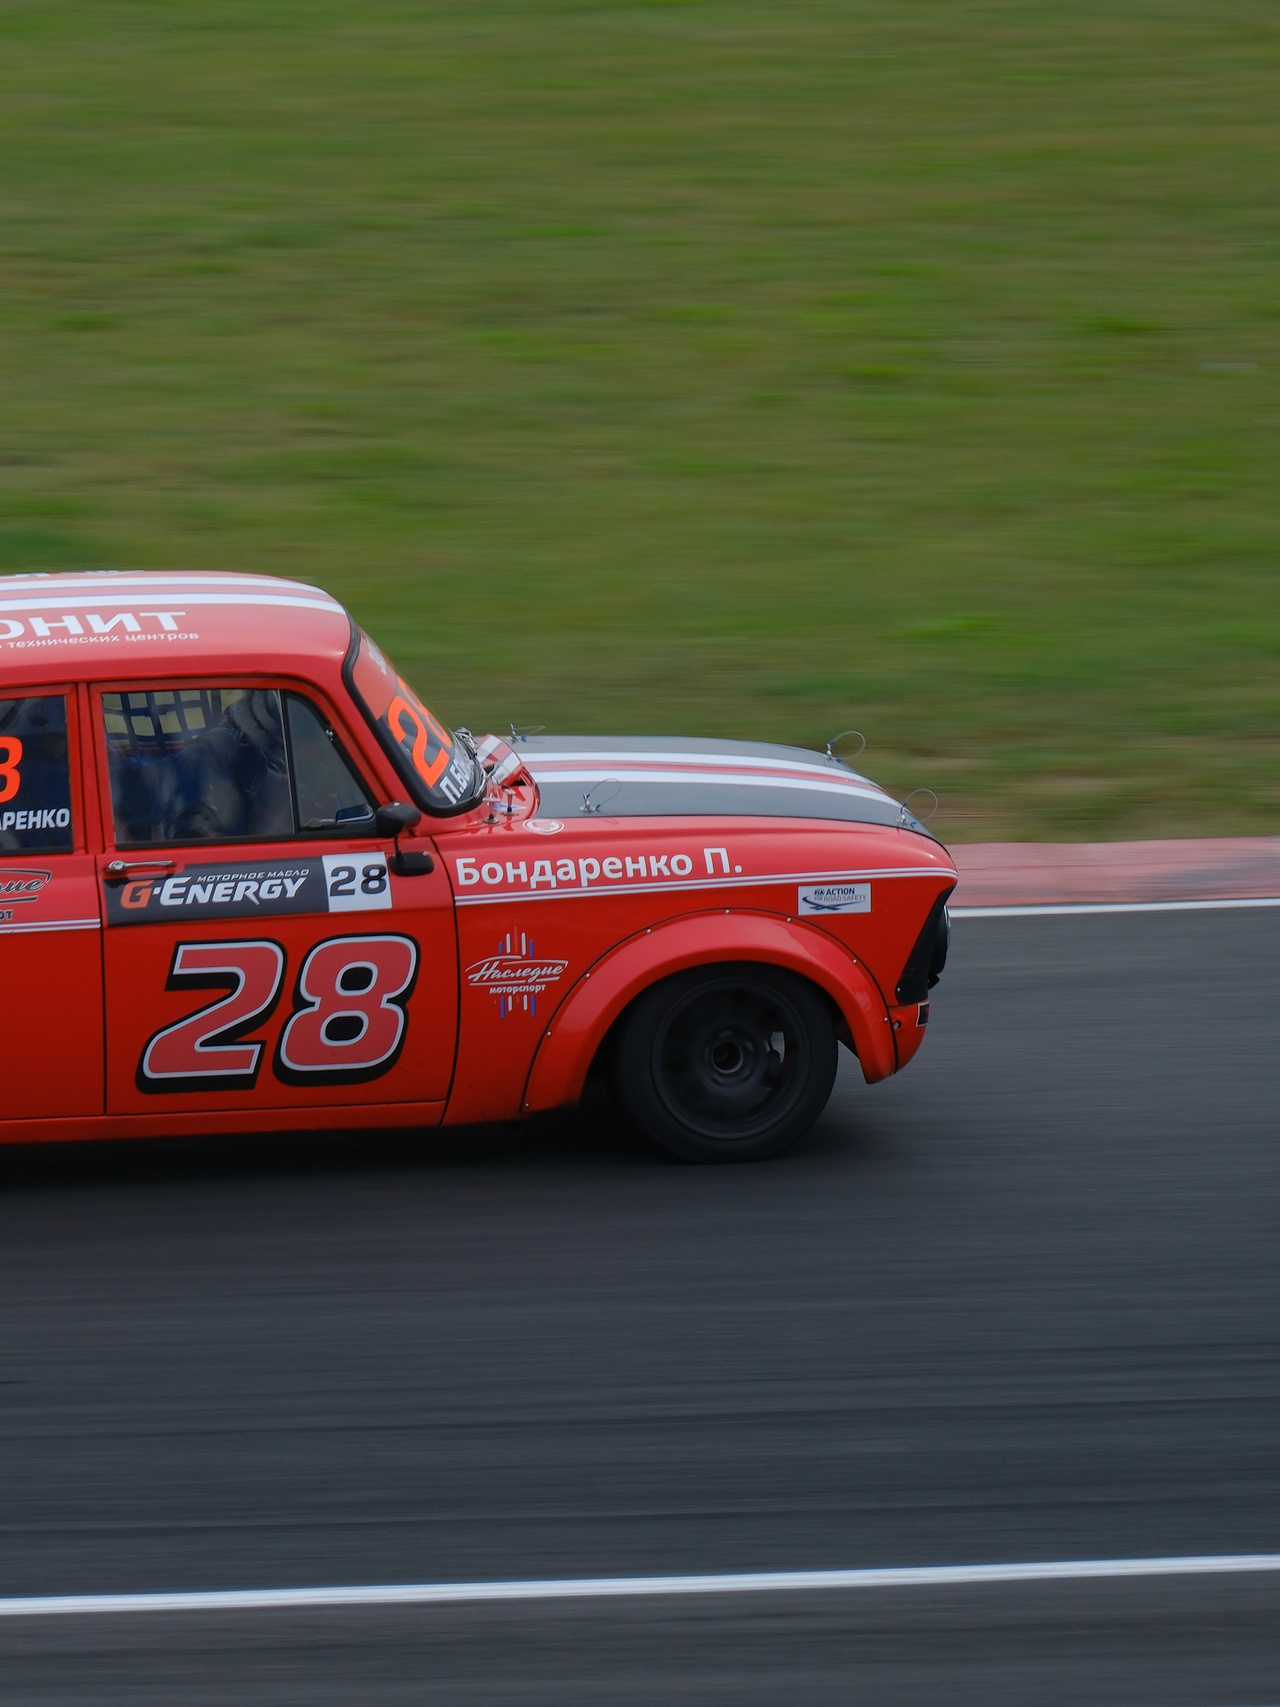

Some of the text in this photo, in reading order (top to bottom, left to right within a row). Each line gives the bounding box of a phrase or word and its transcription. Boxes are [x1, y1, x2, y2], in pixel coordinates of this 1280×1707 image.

[6, 633, 122, 650] технических
[125, 631, 200, 643] центров
[387, 675, 453, 789] 28
[197, 868, 310, 883] МОТОРНОЕ МАСЛО
[456, 847, 743, 889] Бондаренко П.
[329, 864, 387, 896] 28
[826, 887, 855, 895] ACTION
[467, 960, 564, 983] Наследие
[489, 984, 546, 995] моторспорт
[136, 932, 420, 1095] 28
